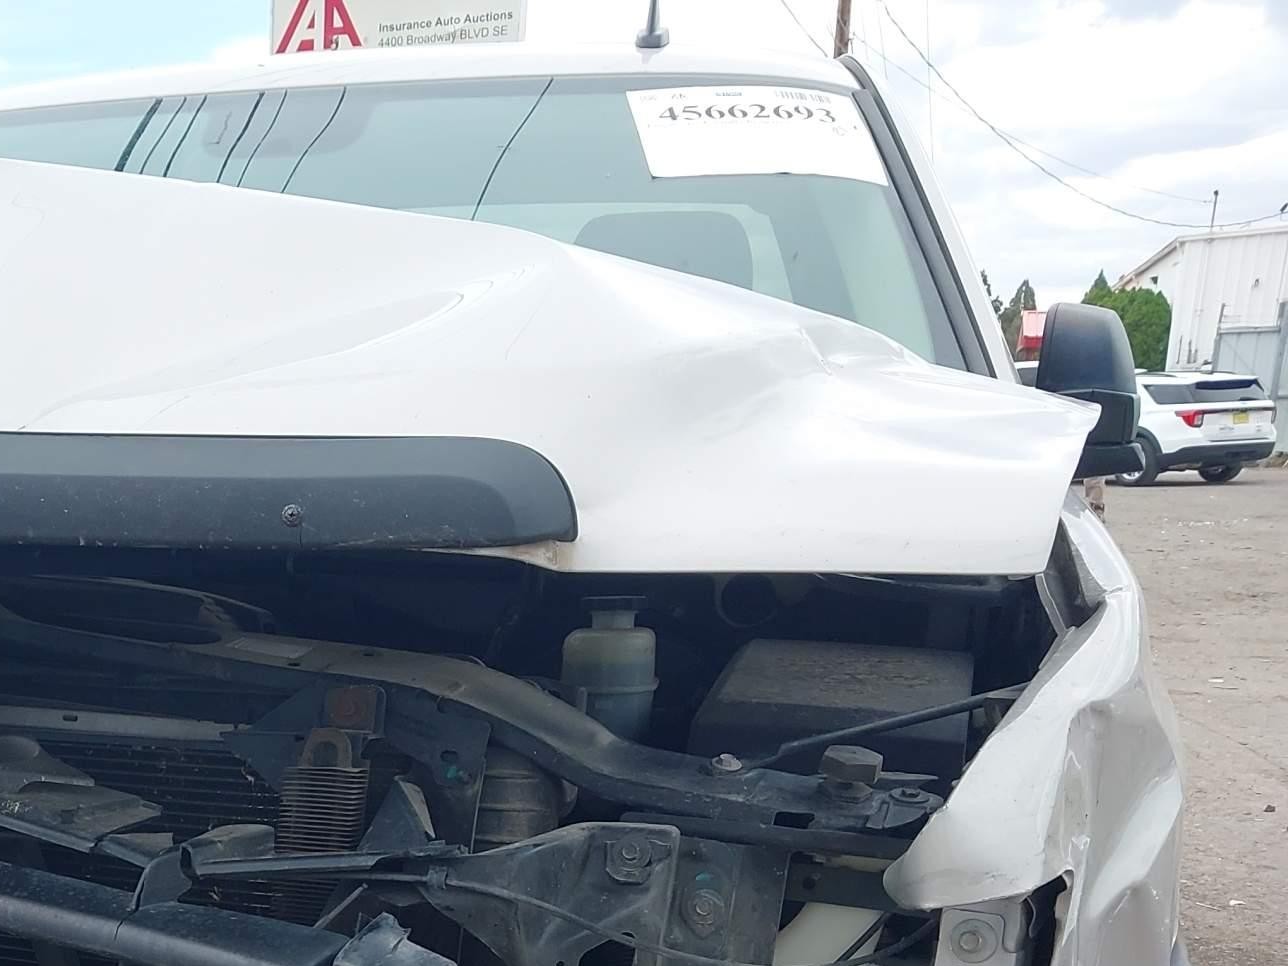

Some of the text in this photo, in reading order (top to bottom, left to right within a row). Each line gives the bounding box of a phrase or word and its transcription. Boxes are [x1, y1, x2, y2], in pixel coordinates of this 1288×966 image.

[378, 10, 514, 33] Insurance Auto Auctions
[378, 24, 509, 48] 4400 Broadway BLVD SE
[658, 103, 837, 124] 45662693
